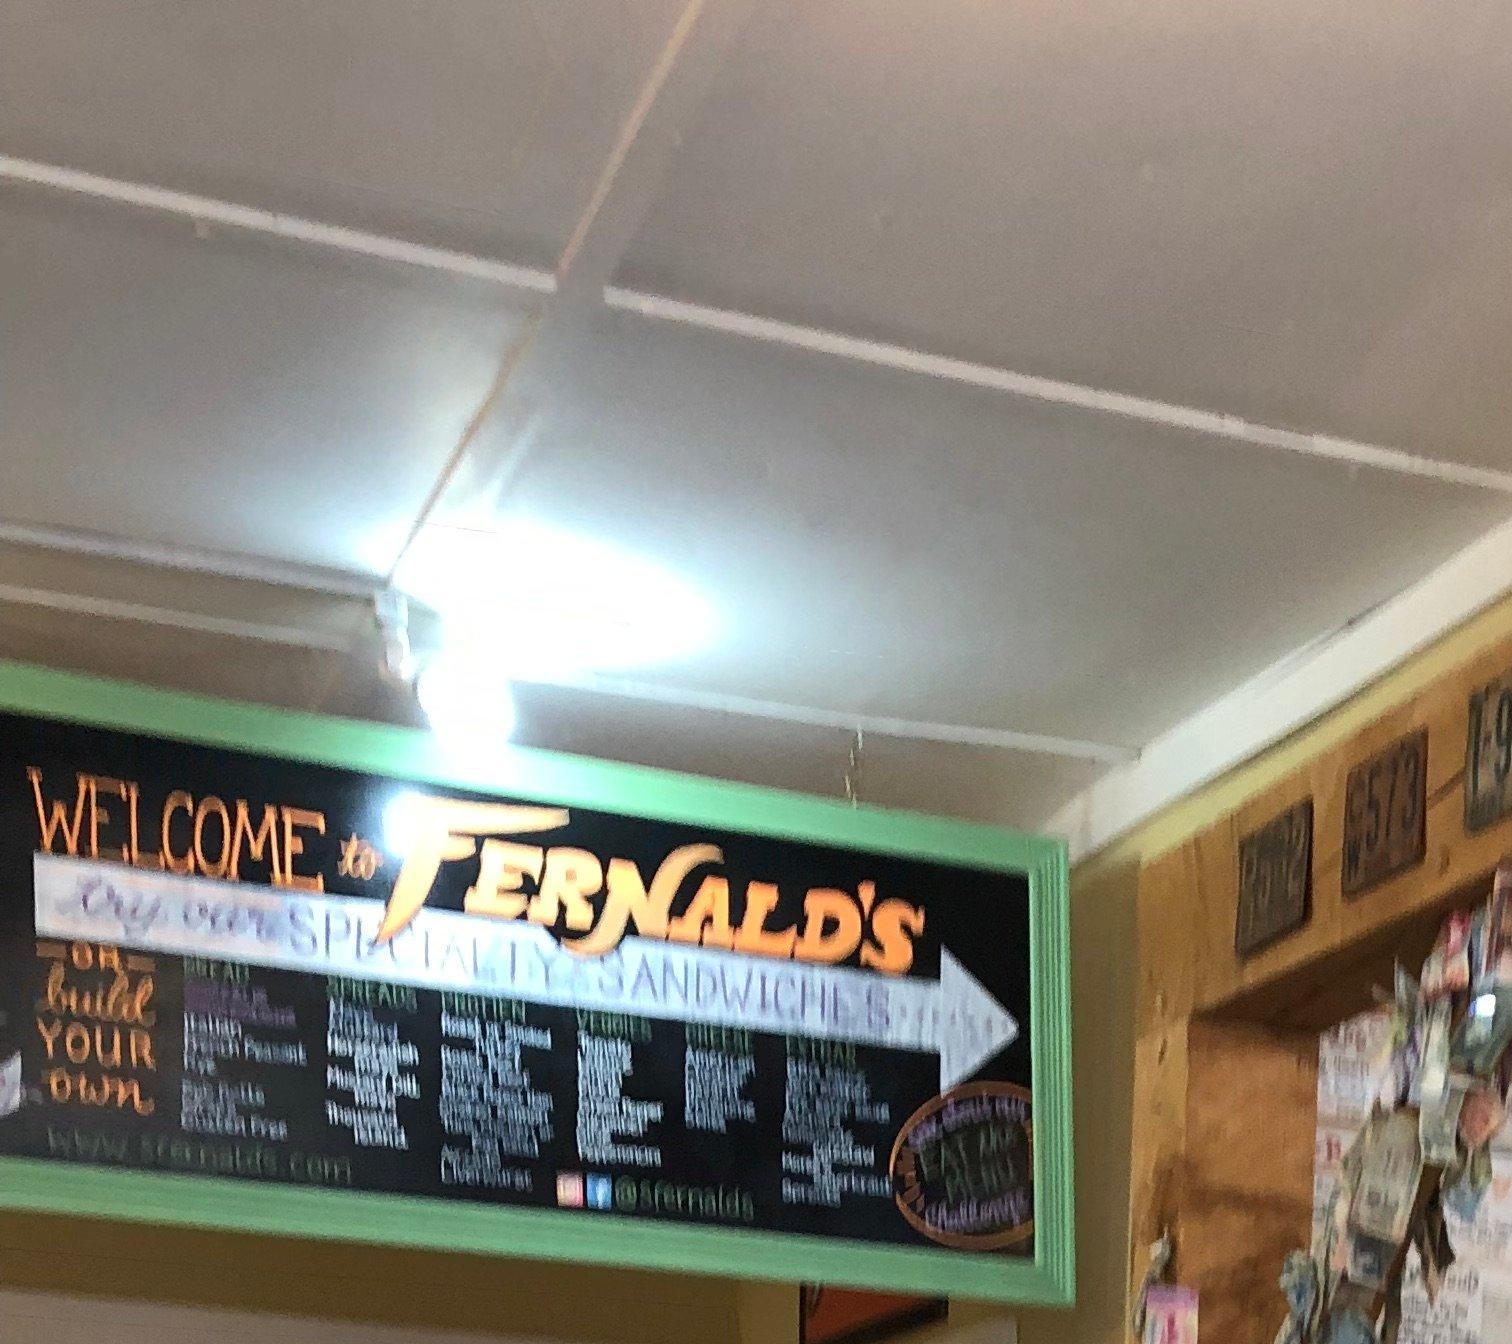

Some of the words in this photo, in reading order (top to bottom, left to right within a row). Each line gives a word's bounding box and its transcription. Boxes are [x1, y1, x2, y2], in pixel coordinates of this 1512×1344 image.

[26, 765, 327, 894] WELCOME
[373, 793, 926, 975] FERNALD'S
[45, 962, 157, 1024] build
[37, 1014, 157, 1072] YOUR
